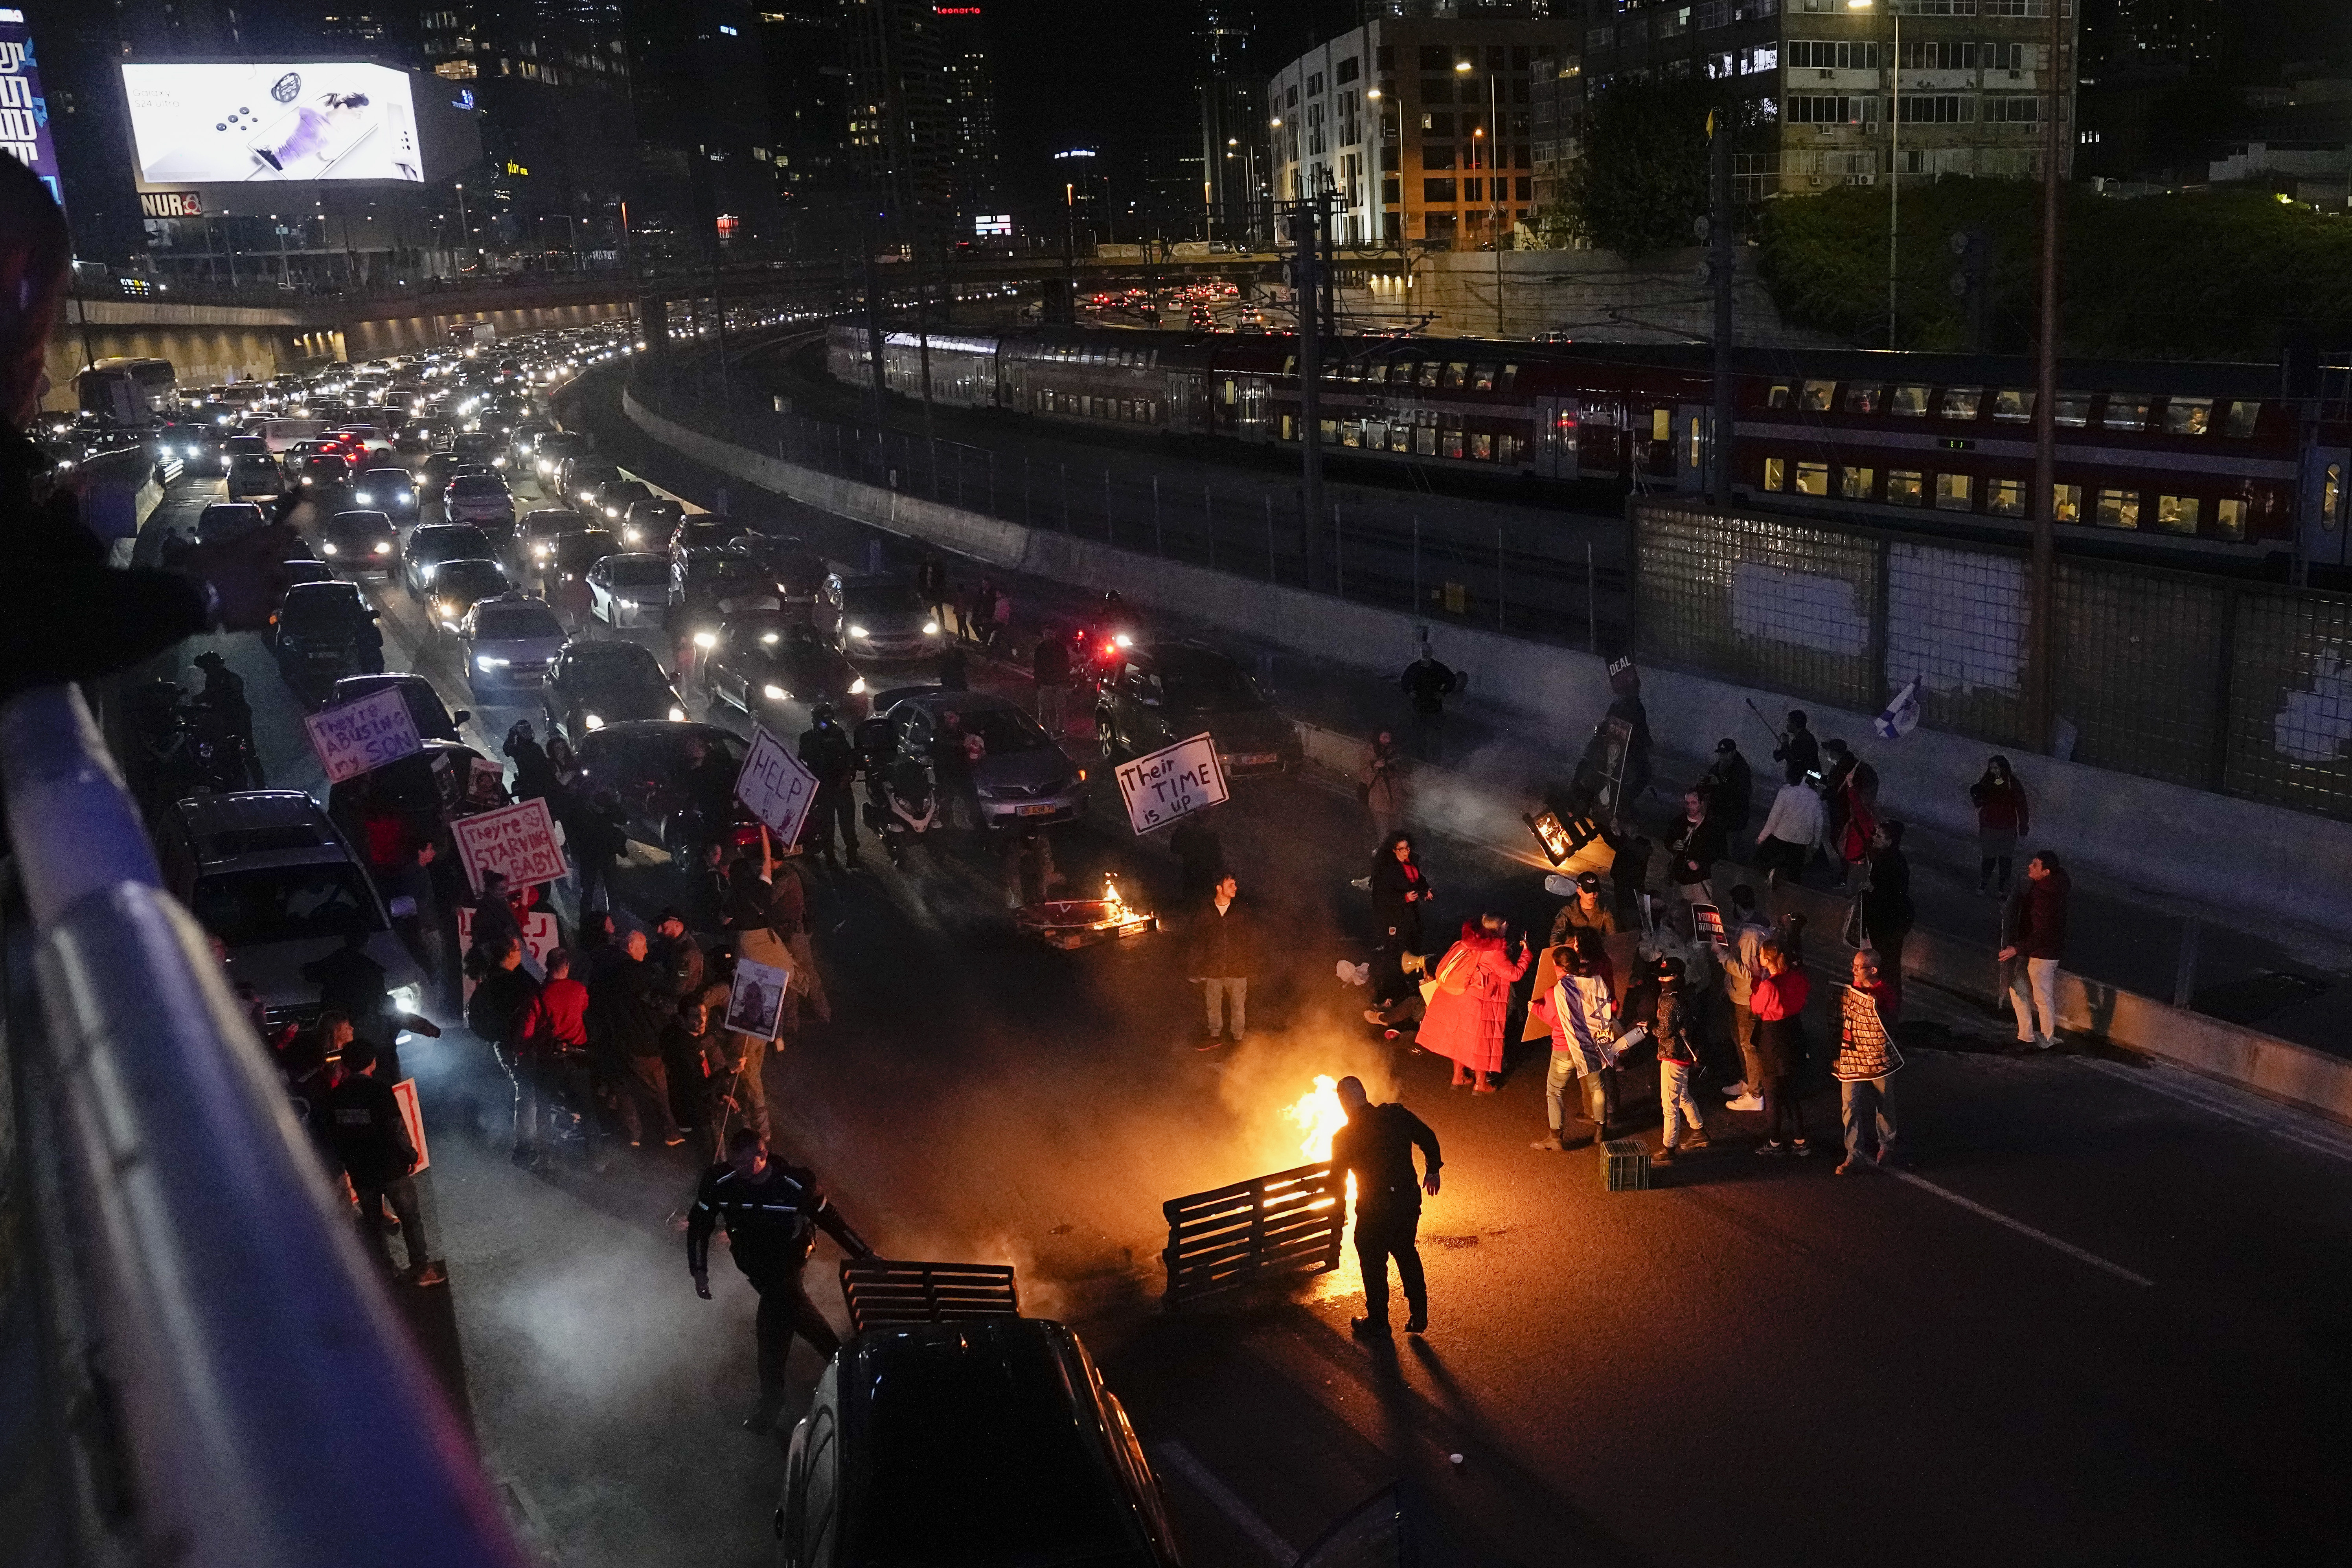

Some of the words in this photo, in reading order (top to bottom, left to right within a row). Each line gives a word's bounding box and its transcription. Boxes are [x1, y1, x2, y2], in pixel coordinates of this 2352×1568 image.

[133, 89, 170, 97] Galaxy
[507, 159, 519, 176] play
[140, 194, 184, 216] NUR
[1609, 655, 1631, 676] DEAL
[327, 711, 405, 757] ABUSING
[366, 731, 413, 763] SON
[752, 749, 802, 803] HELP
[1120, 759, 1175, 791] Their
[1151, 763, 1210, 803] TIME
[1143, 809, 1160, 825] is
[474, 830, 549, 871] STARVING
[510, 849, 554, 880] BABY
